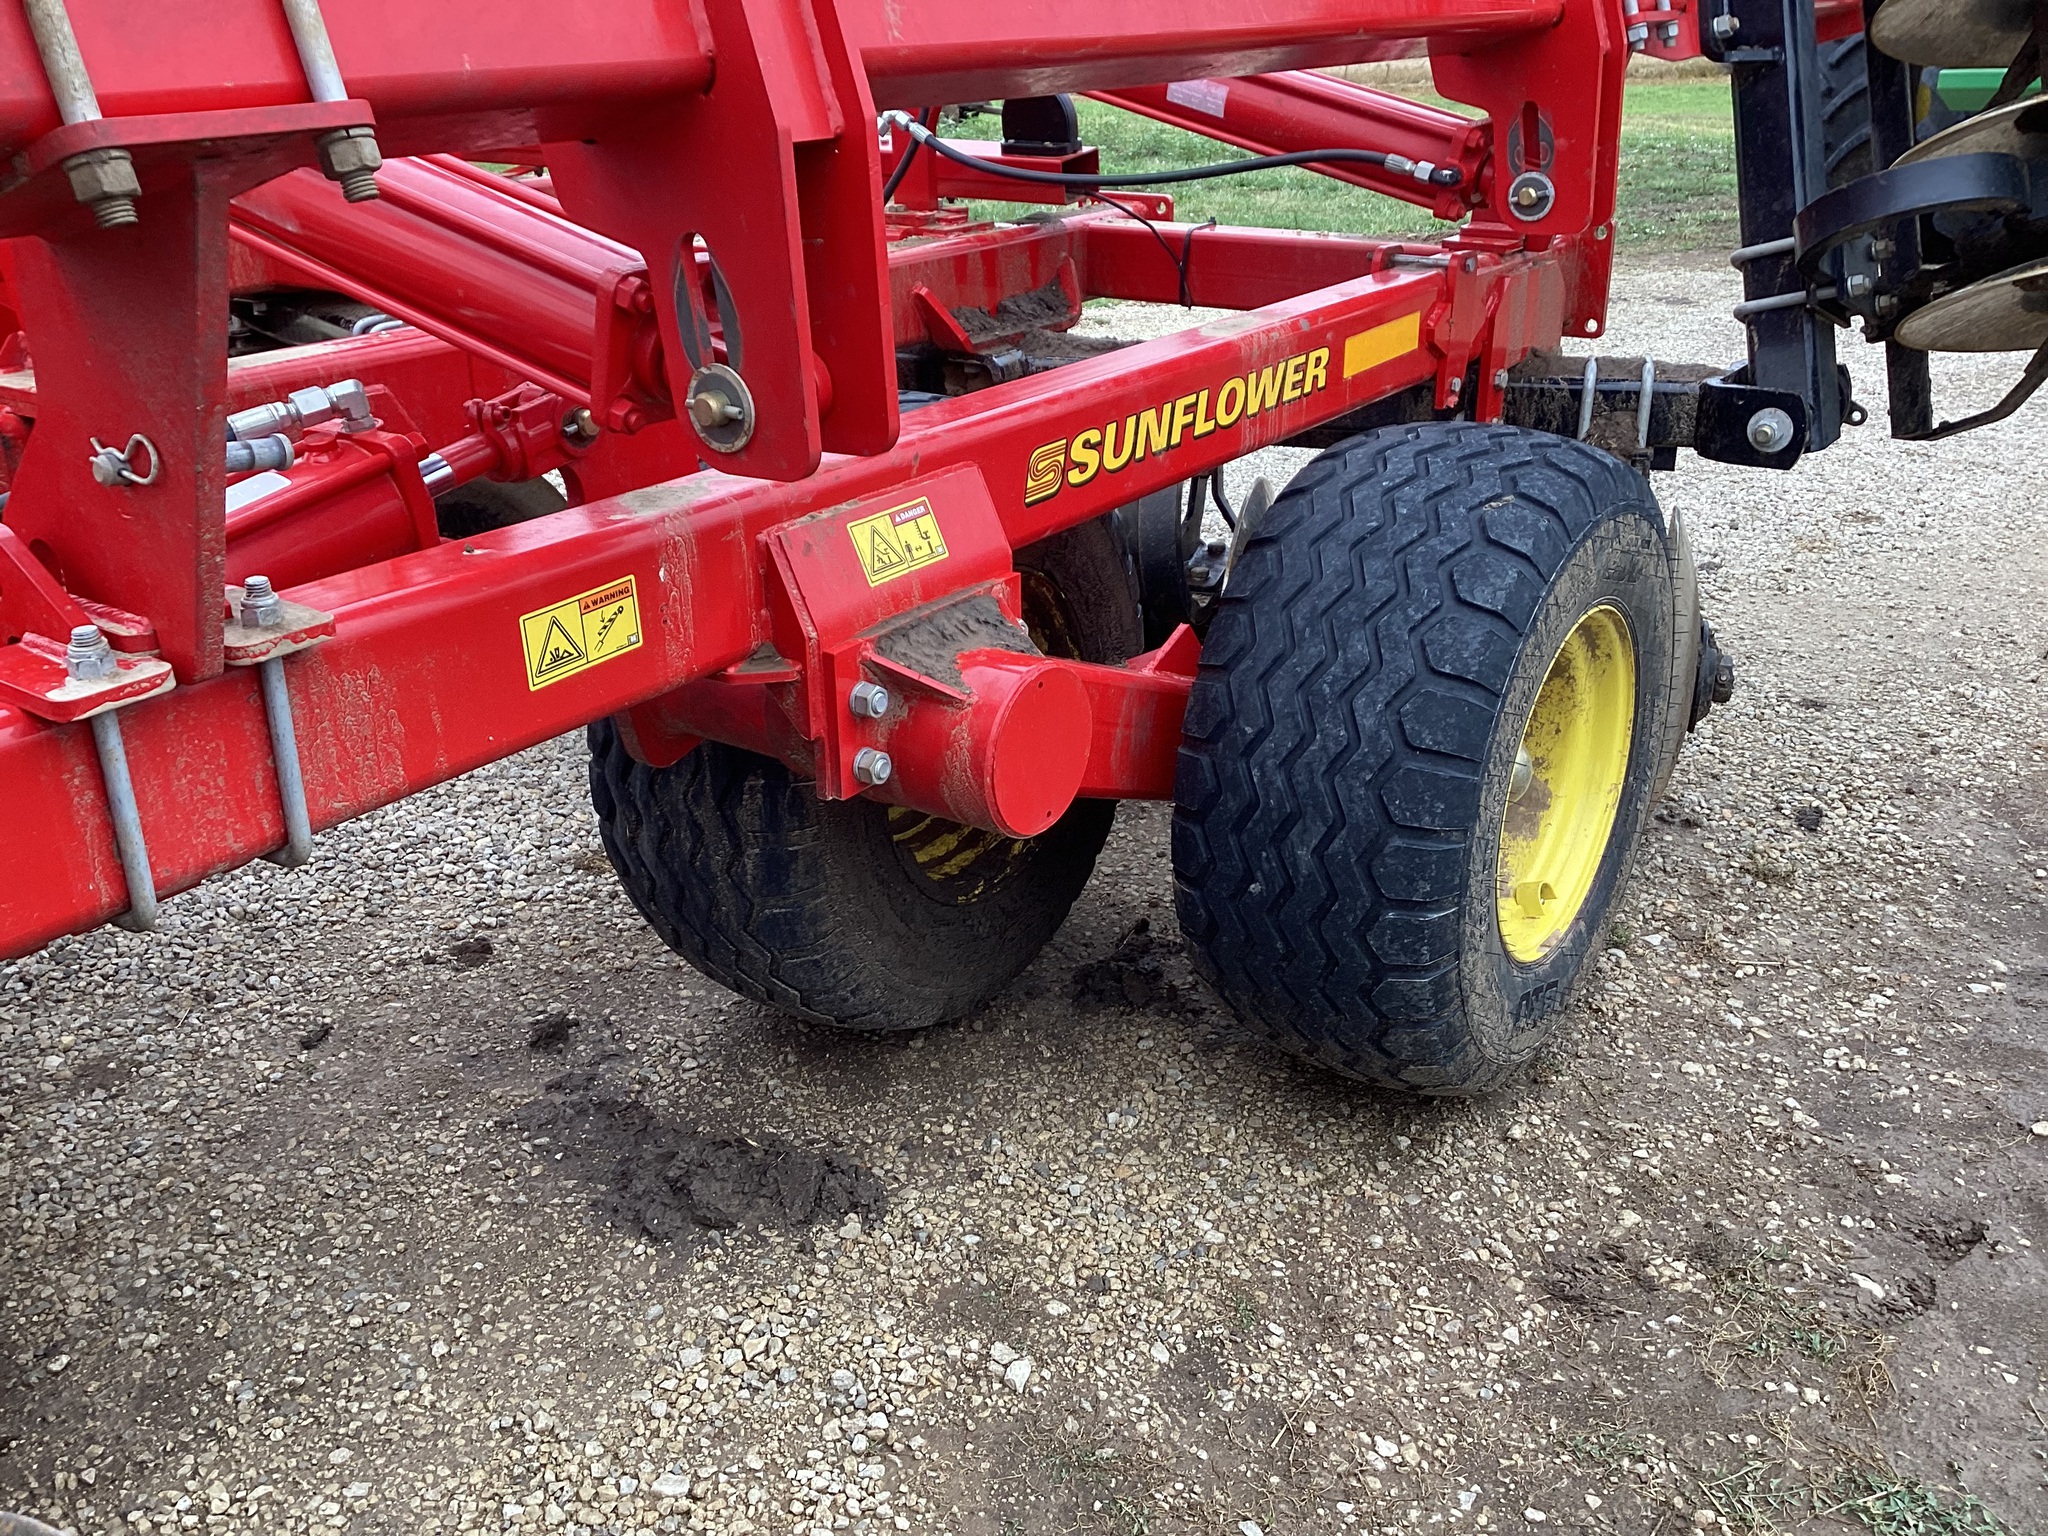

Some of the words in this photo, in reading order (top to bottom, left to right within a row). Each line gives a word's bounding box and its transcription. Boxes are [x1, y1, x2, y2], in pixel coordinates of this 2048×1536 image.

[1067, 347, 1330, 487] SUNFLOWER
[899, 505, 926, 520] DANGER
[590, 586, 630, 607] WARNING
